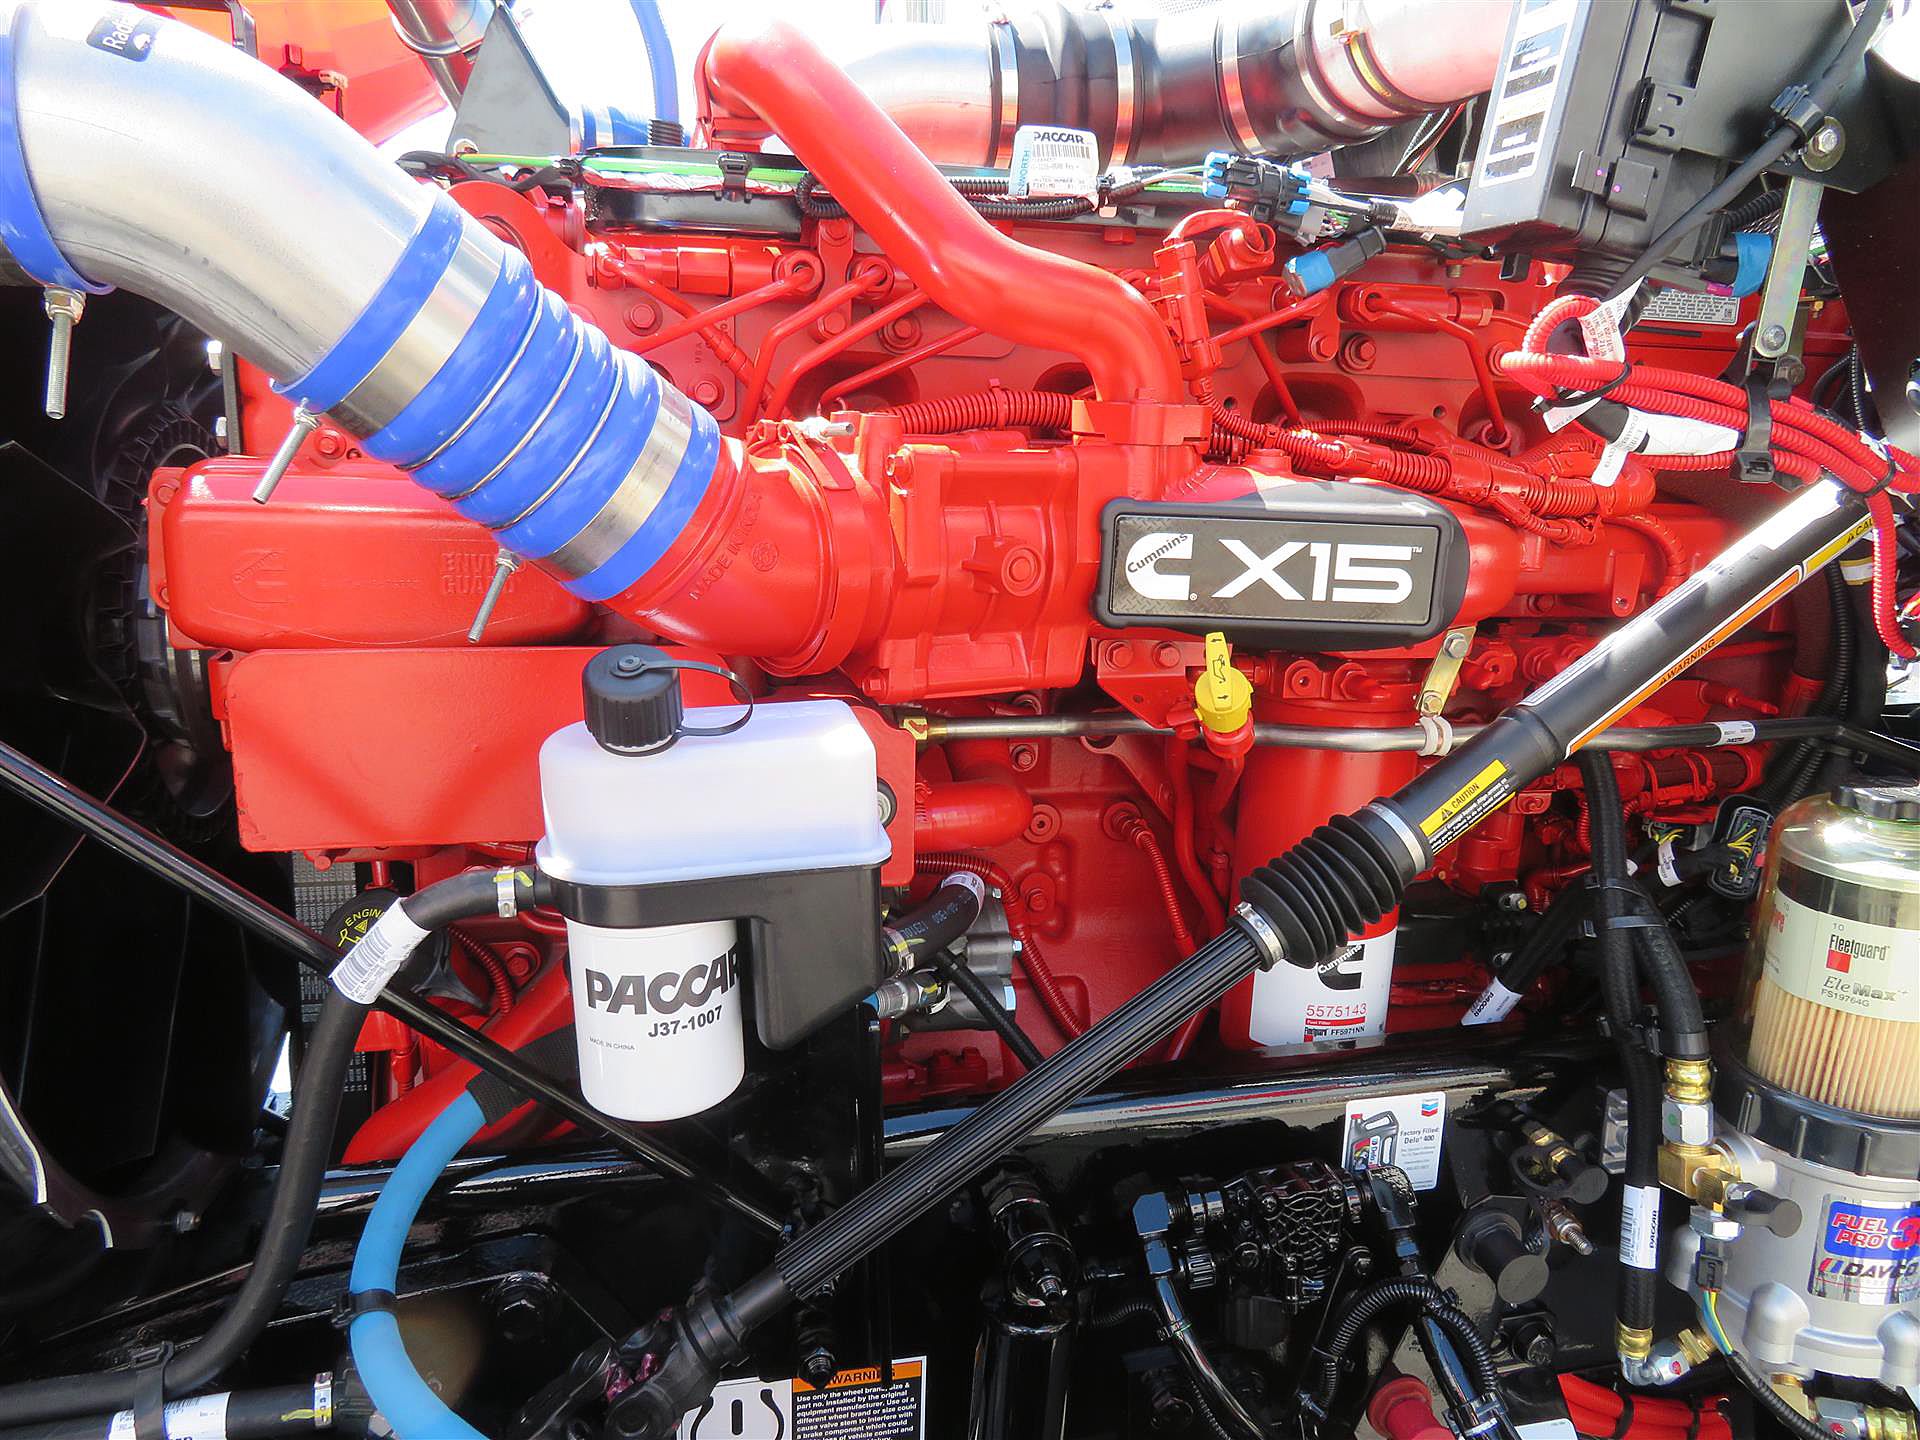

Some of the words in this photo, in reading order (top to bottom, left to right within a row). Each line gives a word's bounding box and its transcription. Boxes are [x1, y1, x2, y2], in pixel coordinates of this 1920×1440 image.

[1033, 131, 1084, 144] PACCAR
[1127, 532, 1188, 573] Cummins
[1211, 538, 1412, 603] X15
[1661, 638, 1716, 680] WARNING
[1451, 782, 1480, 809] CAUTION
[1832, 923, 1844, 932] 10
[1829, 934, 1888, 961] Fleetguard
[1318, 945, 1362, 974] Cummins
[1821, 989, 1870, 1007] FS19764G
[1306, 1003, 1367, 1017] 5575143
[648, 1005, 722, 1037] J37-1007
[590, 1036, 603, 1046] MADE
[1832, 1213, 1888, 1234] FUEL
[1835, 1229, 1886, 1249] PRO
[796, 1403, 812, 1412] part
[826, 1397, 857, 1407] installed
[880, 1390, 908, 1399] original
[812, 1393, 828, 1402] only
[796, 1408, 834, 1418] equipment
[836, 1402, 885, 1412] manufacturer.
[796, 1416, 826, 1425] different
[828, 1413, 849, 1421] wheel
[850, 1410, 872, 1418] brand
[882, 1406, 896, 1414] size
[897, 1404, 917, 1412] could
[796, 1425, 818, 1433] cause
[820, 1422, 839, 1430] valve
[868, 1414, 897, 1423] interfere
[802, 1430, 823, 1439] brake
[824, 1427, 865, 1438] component
[866, 1422, 886, 1430] which
[888, 1419, 908, 1428] could
[848, 1431, 873, 1440] vehicle
[874, 1428, 899, 1436] control
